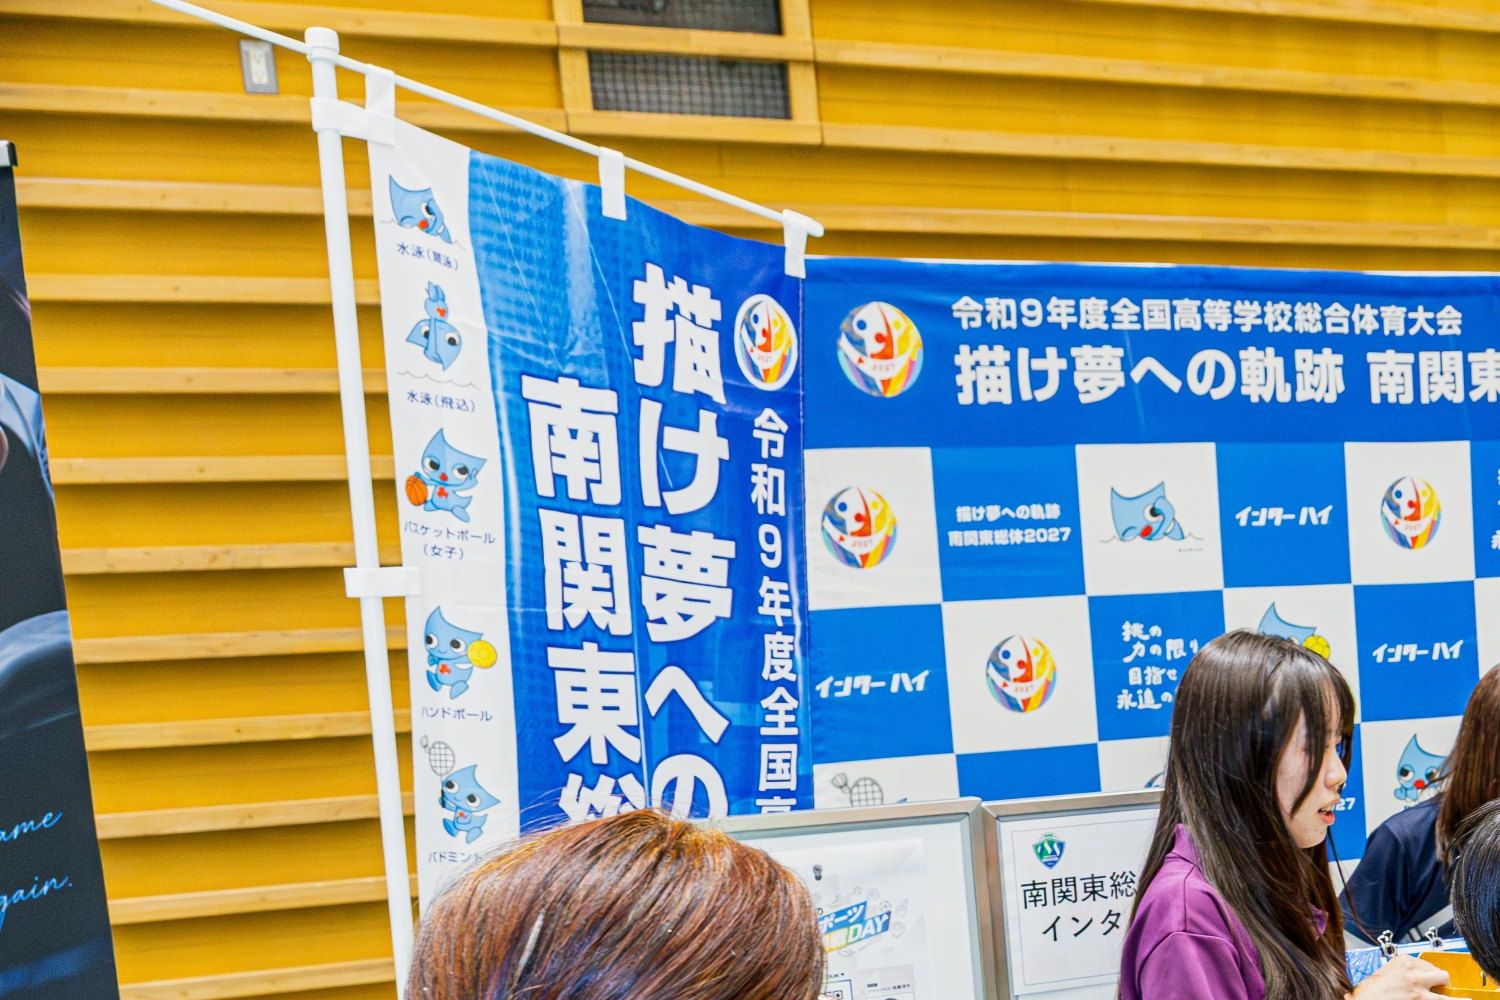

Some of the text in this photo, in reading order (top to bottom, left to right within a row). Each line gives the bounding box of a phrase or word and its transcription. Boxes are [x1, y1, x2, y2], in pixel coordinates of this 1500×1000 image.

[951, 295, 1462, 336] 令和9年度全国高等学校総合体育大会
[954, 344, 1345, 405] 描け夢への軌跡
[1235, 505, 1333, 528] インターハイ
[423, 544, 465, 560] (女子)
[1372, 640, 1464, 663] インターハイ
[815, 669, 930, 699] インターハイ
[1117, 688, 1178, 711] 永遠の
[420, 706, 493, 724] ハンドボール
[1021, 870, 1139, 909] 南関東総
[1042, 909, 1121, 941] インタ
